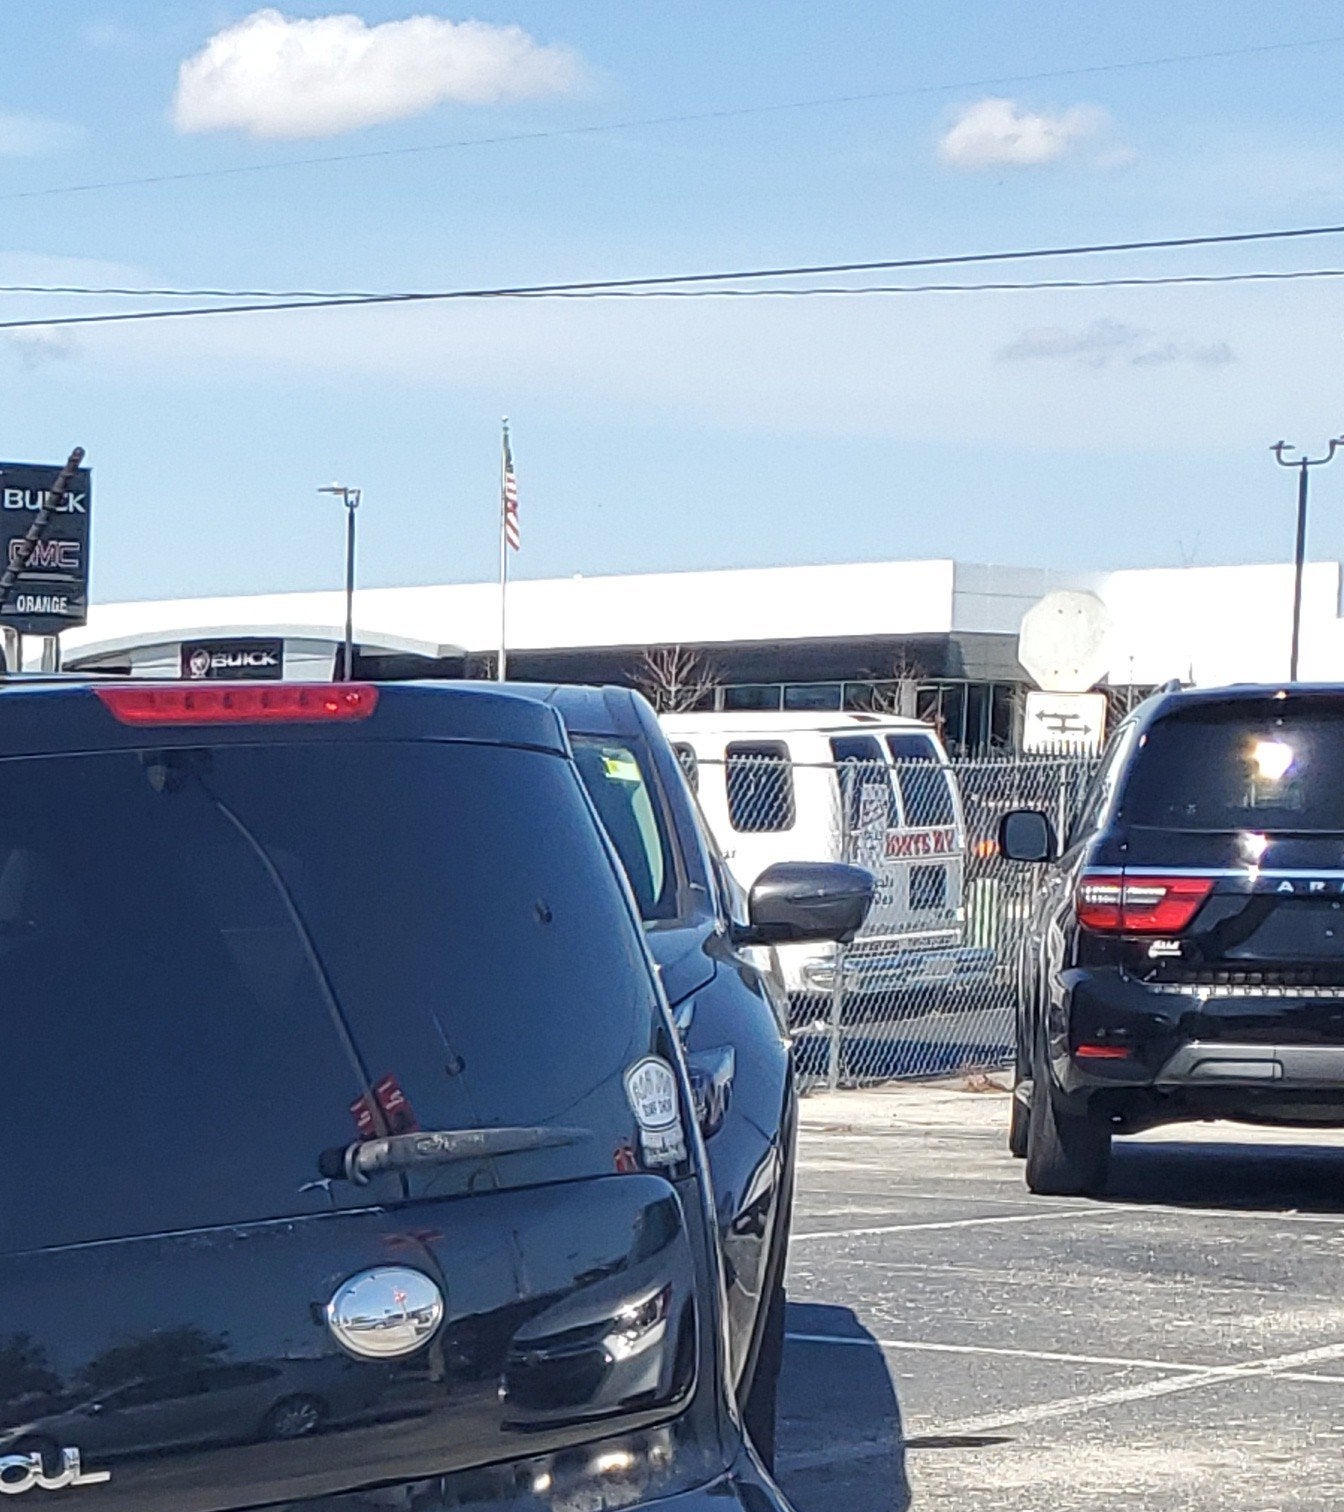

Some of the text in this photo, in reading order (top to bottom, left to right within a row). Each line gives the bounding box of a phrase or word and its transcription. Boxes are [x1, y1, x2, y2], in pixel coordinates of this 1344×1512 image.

[16, 595, 68, 613] ORANGE
[210, 651, 279, 668] BUICK
[1276, 880, 1344, 893] AR
